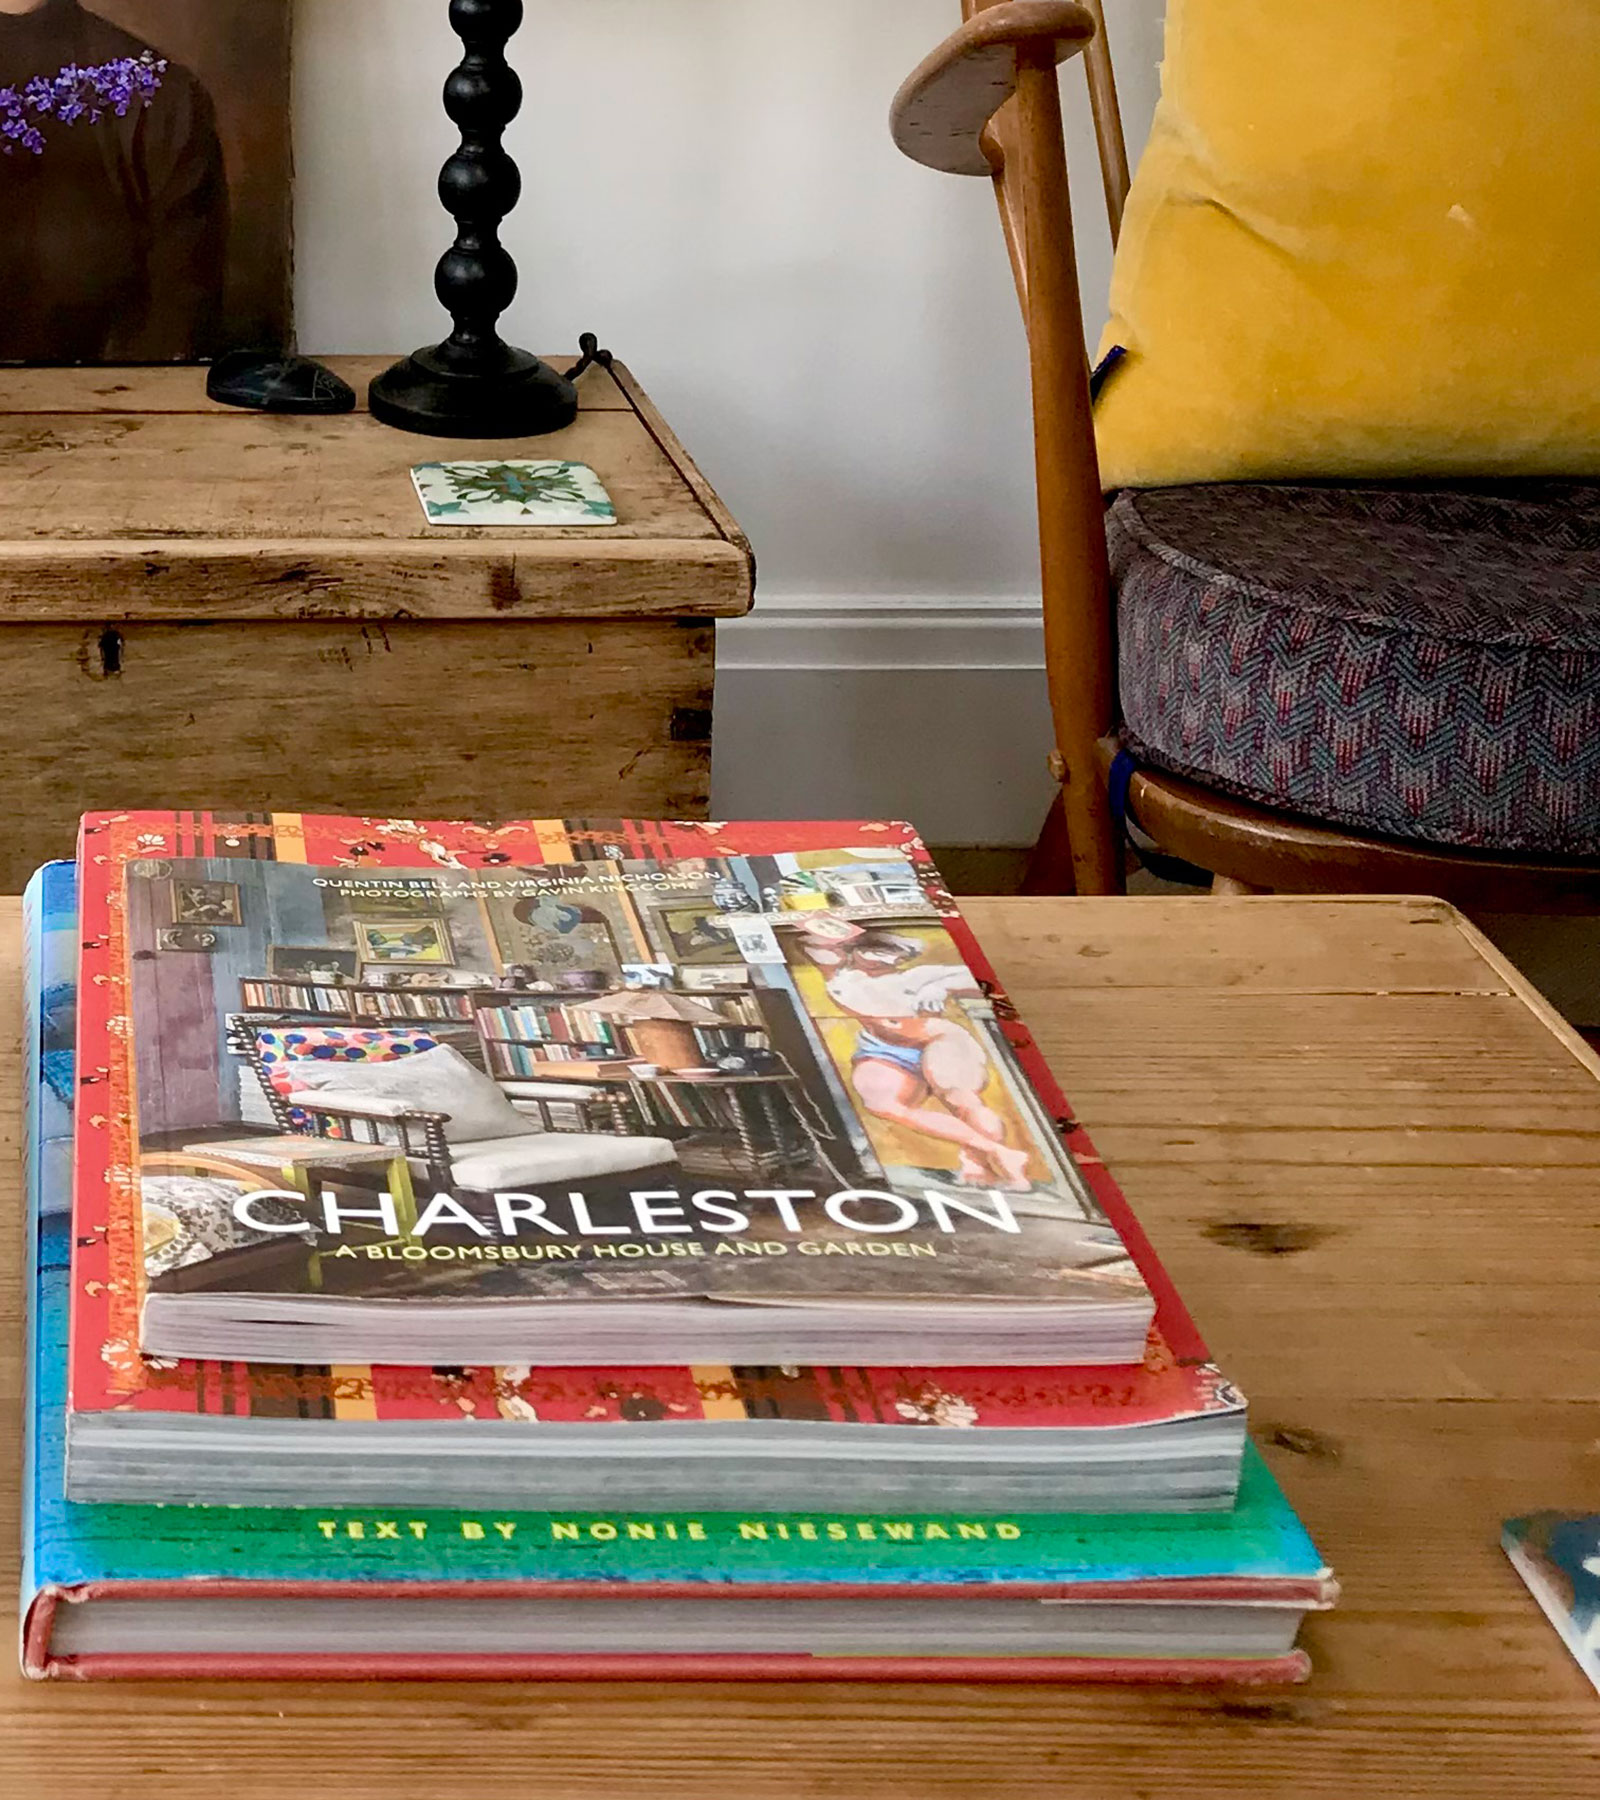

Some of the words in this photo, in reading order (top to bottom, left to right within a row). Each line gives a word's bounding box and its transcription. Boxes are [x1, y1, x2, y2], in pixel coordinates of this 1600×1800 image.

[312, 878, 405, 889] QUENTIN
[409, 879, 451, 889] BELL
[456, 880, 501, 889] AND
[506, 876, 594, 888] VIRGINIA
[600, 871, 720, 881] NICHOLSON
[340, 889, 488, 899] PHOTOGRAPHS
[493, 889, 517, 898] BY
[521, 887, 584, 897] GAVIN
[590, 882, 698, 893] KINGCOME
[232, 1189, 1022, 1236] CHARLESTON
[335, 1244, 358, 1259] A
[366, 1244, 583, 1260] BLOOMSBURY
[593, 1242, 706, 1258] HOUSE
[715, 1242, 789, 1257] AND
[797, 1240, 937, 1257] GARDEN
[318, 1522, 428, 1539] TEXT
[461, 1521, 517, 1540] BY
[551, 1521, 708, 1541] NONIE
[738, 1521, 1024, 1541] NIESEWAND
